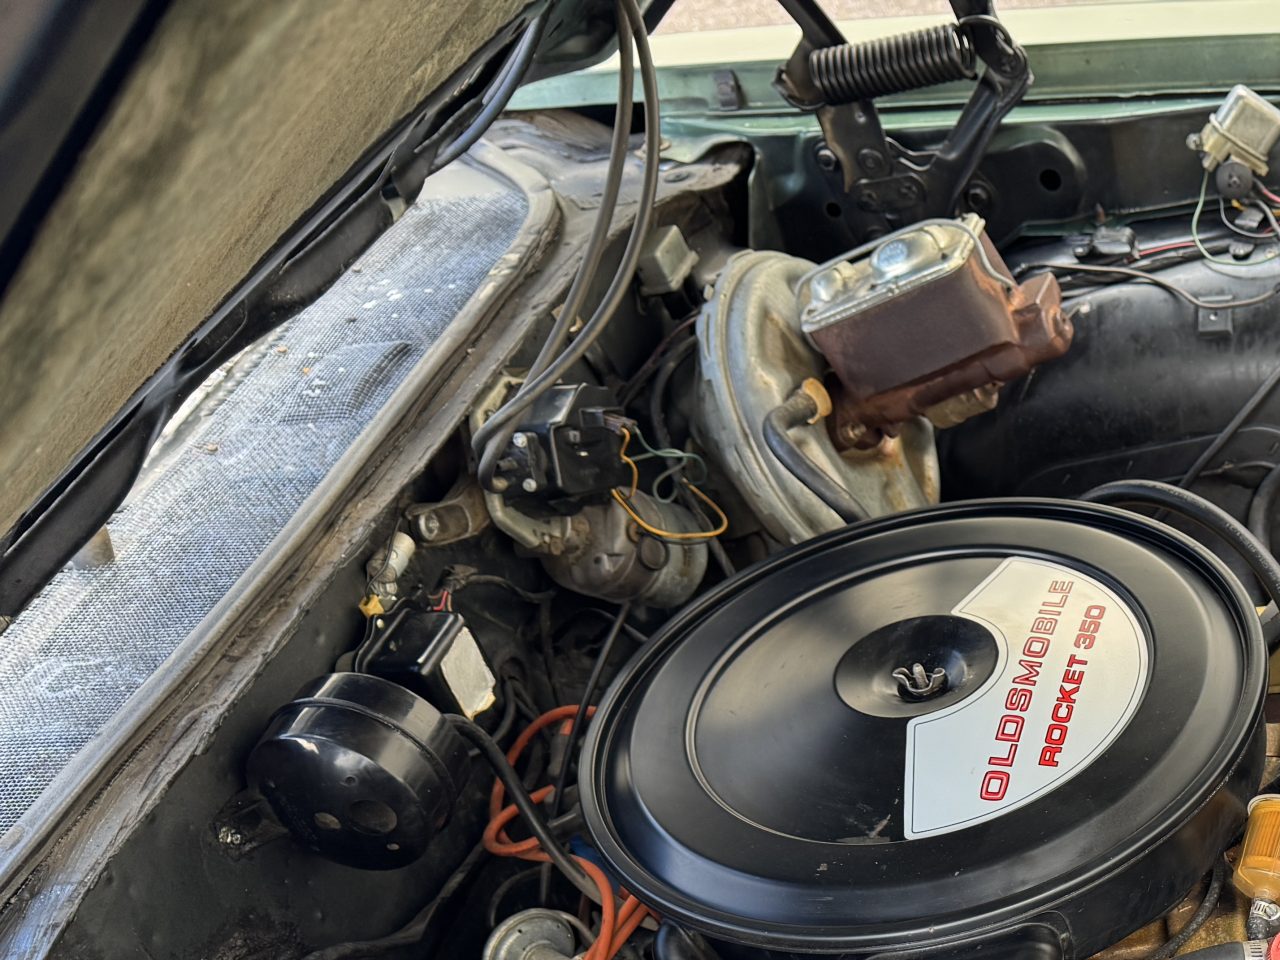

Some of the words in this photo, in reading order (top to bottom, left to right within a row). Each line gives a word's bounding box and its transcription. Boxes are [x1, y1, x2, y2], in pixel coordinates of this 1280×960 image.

[979, 579, 1075, 802] OLDSMOBILE
[1038, 654, 1088, 767] ROCKET
[1073, 605, 1106, 650] 350
